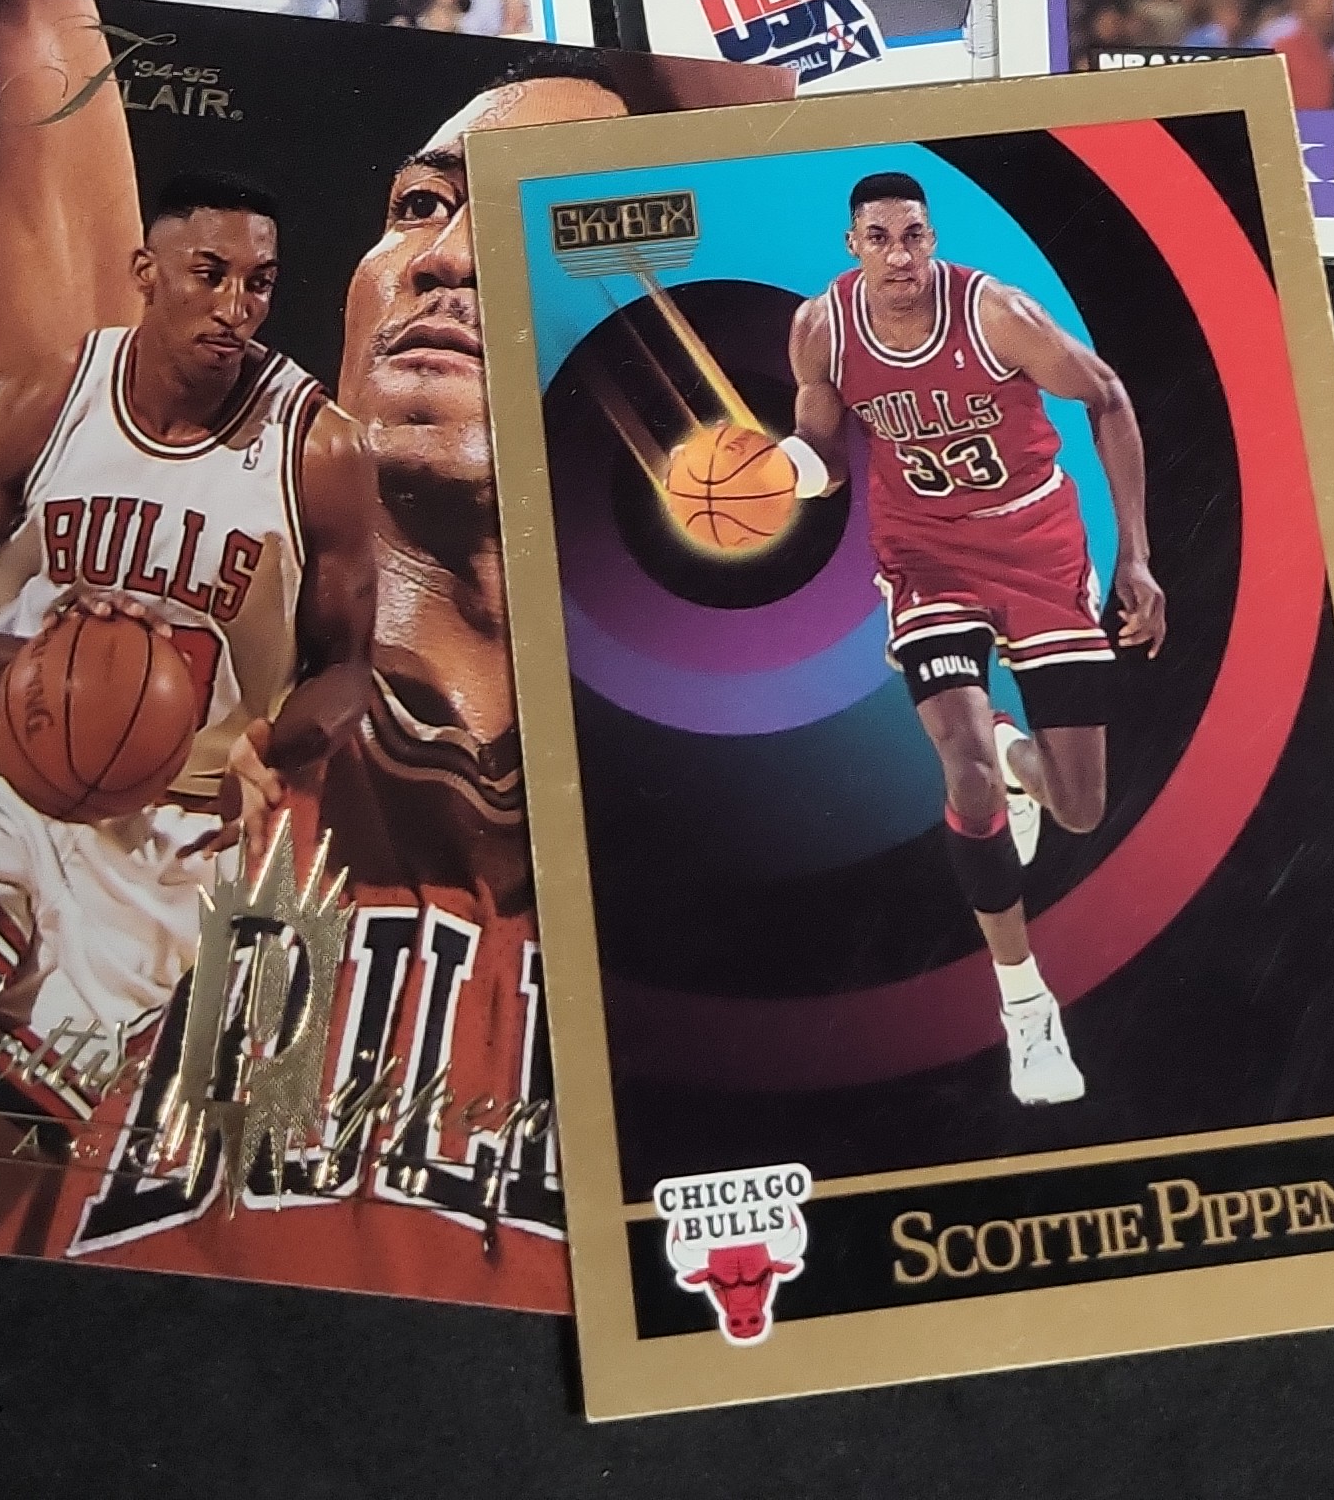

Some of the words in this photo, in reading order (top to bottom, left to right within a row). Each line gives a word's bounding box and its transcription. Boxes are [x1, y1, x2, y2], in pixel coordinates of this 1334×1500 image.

[556, 197, 693, 246] SKYBOX
[895, 433, 1009, 498] 33
[44, 495, 264, 622] BULLS
[930, 655, 980, 678] BULLS
[659, 1171, 806, 1212] CHICAGO
[683, 1205, 785, 1241] BULLS
[891, 1203, 1148, 1285] SCOTTIE
